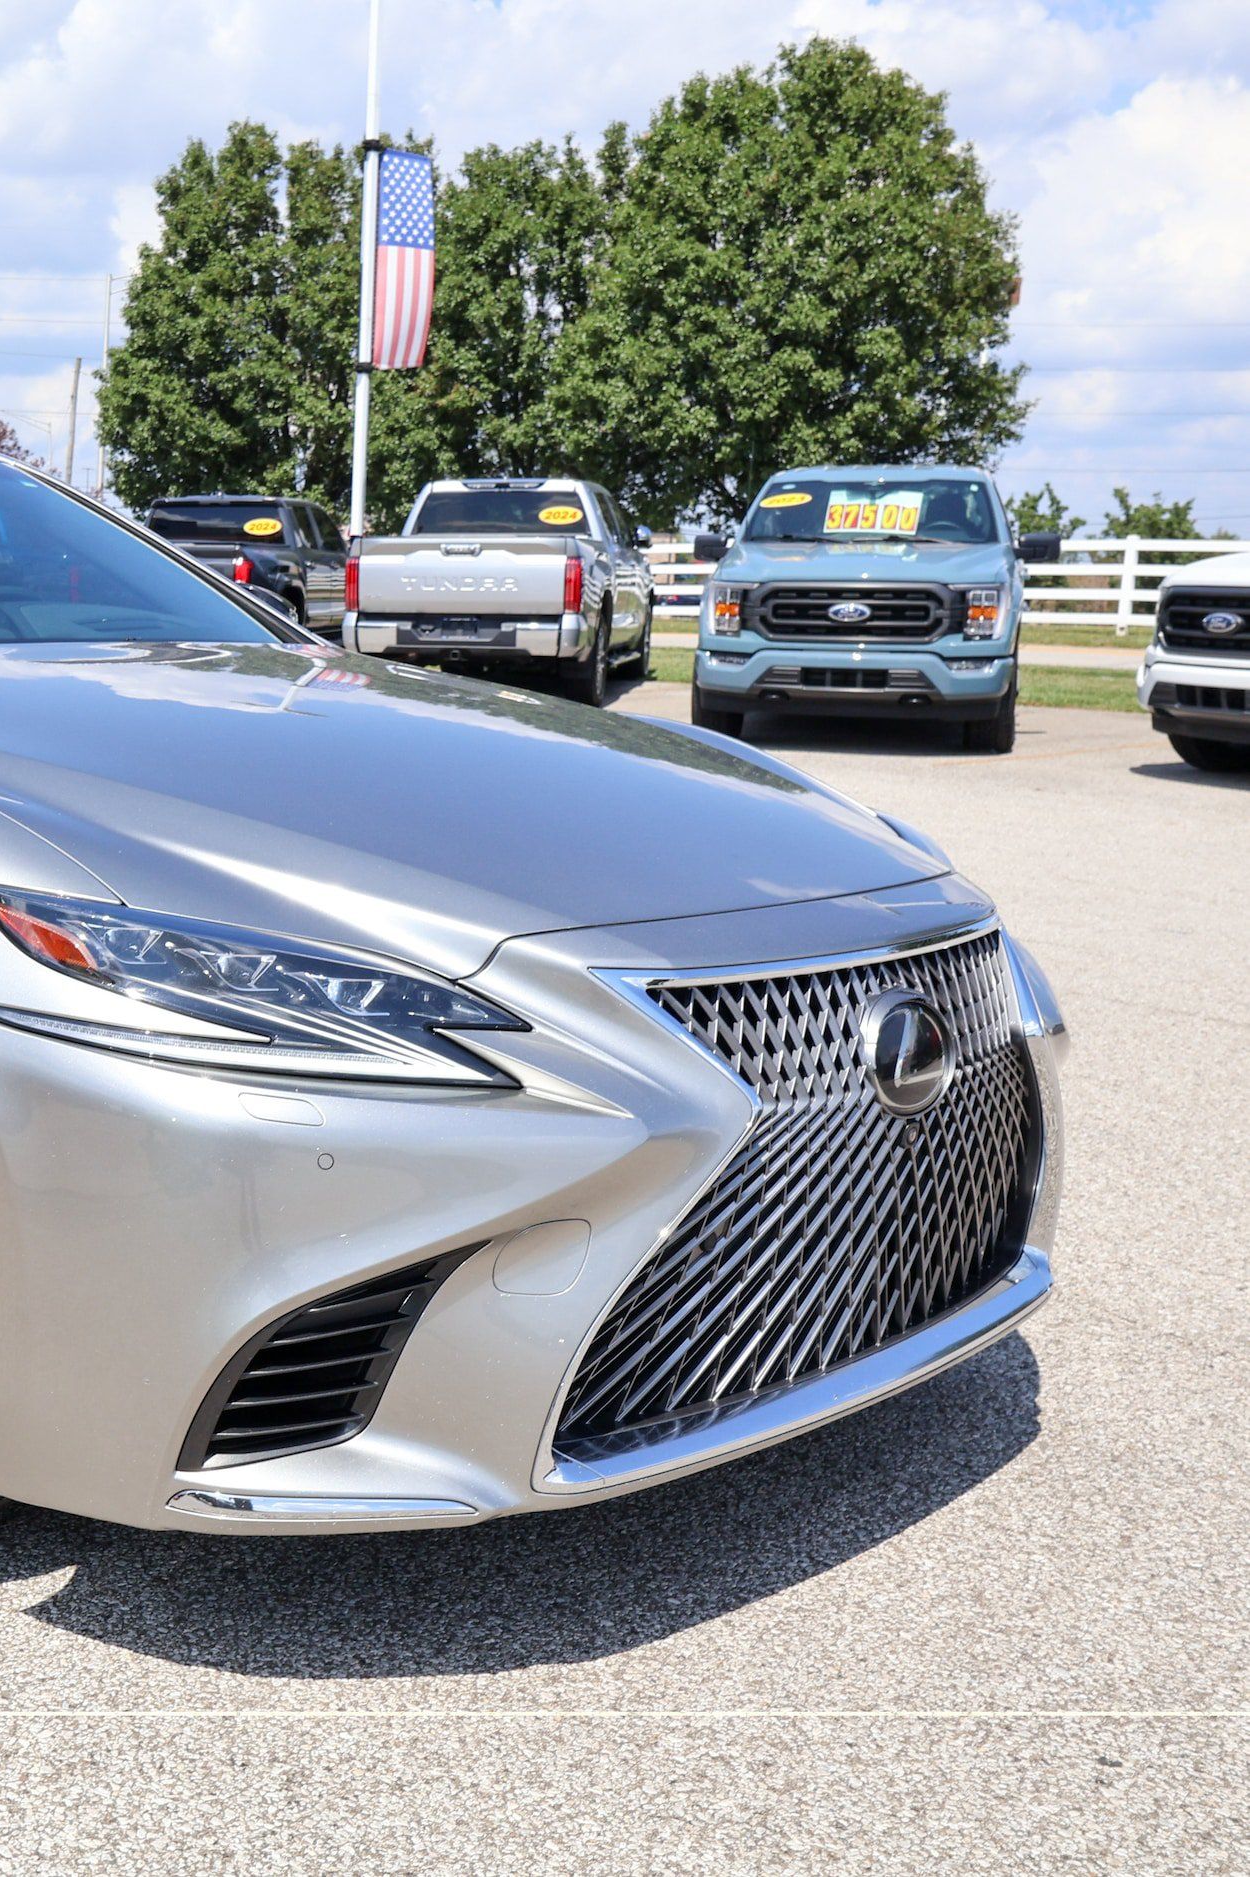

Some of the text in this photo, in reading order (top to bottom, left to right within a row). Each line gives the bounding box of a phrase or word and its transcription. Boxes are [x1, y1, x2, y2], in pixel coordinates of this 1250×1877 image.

[545, 511, 577, 520] 2024
[827, 504, 918, 531] 37500
[249, 523, 277, 531] 2024
[400, 577, 518, 591] TUNDRA
